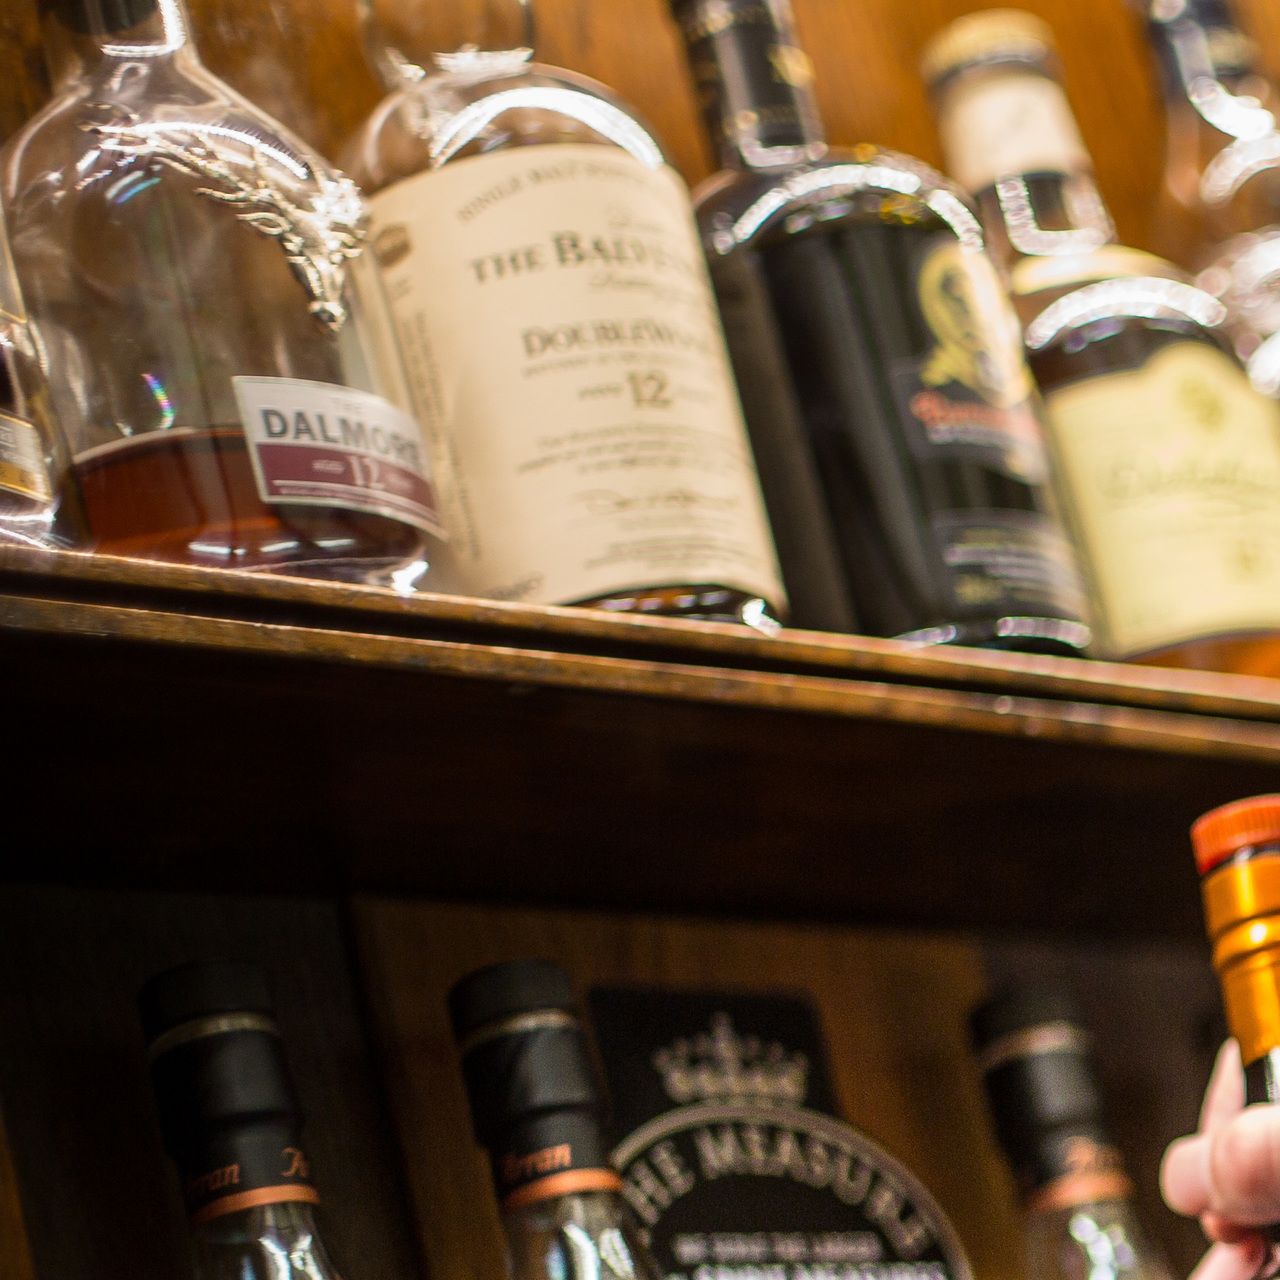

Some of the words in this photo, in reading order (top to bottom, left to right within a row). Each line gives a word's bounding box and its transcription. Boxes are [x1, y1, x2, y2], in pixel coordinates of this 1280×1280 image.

[469, 245, 543, 286] THE
[551, 229, 690, 277] BALVE
[628, 370, 673, 408] 12
[259, 408, 421, 471] DALMORE
[350, 455, 386, 490] 12
[623, 1138, 697, 1226] HE
[695, 1122, 932, 1257] MEASURE
